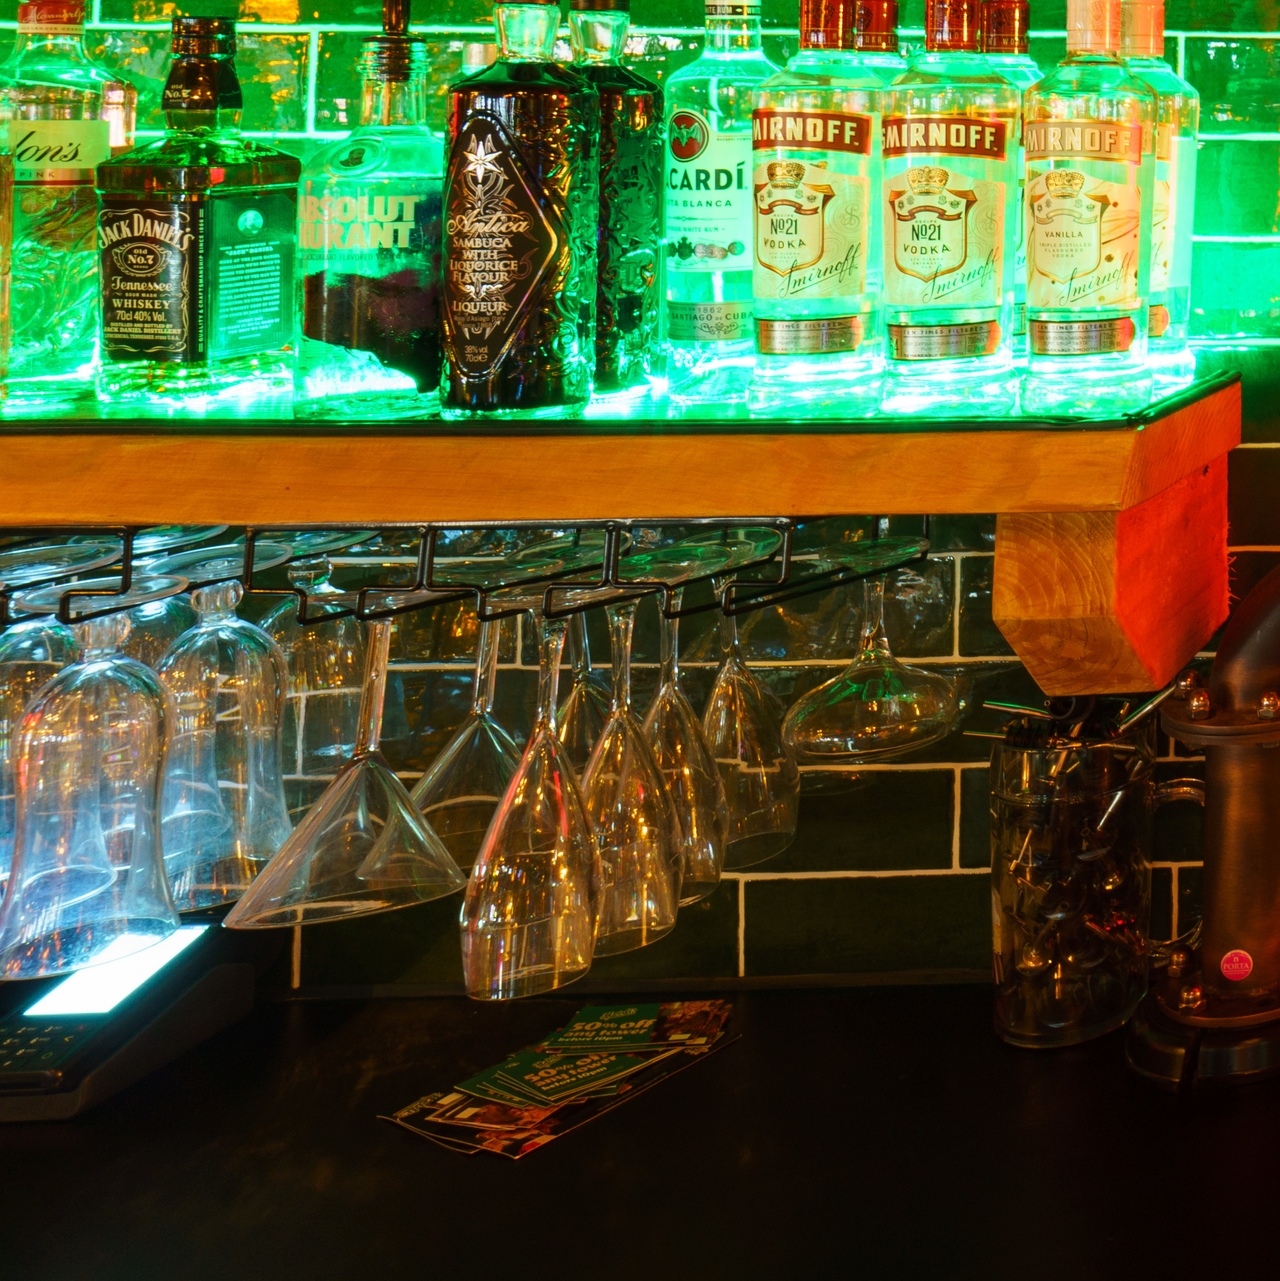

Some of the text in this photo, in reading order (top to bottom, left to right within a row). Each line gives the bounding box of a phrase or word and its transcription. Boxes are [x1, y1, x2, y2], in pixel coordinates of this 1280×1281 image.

[164, 89, 191, 100] No.7
[19, 171, 56, 179] PINK
[446, 208, 531, 236] Antica
[98, 212, 196, 252] JACK DANIEL'S
[1044, 230, 1084, 239] VANILLA
[452, 236, 513, 249] SAMBUCA
[763, 236, 807, 250] VODKA
[462, 249, 498, 260] WITH
[903, 242, 953, 257] VODKA
[127, 254, 155, 265] No.7
[450, 260, 519, 273] LIQUORICE
[779, 242, 862, 299] Smirnoff
[453, 271, 511, 283] FLAVOUR
[1058, 249, 1135, 307] Smirnoff
[111, 275, 173, 293] Tennessee
[112, 298, 172, 311] WHISKEY
[453, 300, 510, 316] LIQUEUR
[697, 306, 723, 315] 1862
[116, 310, 167, 322] 70cl 40% Vol.
[671, 312, 714, 323] SANTIAGO
[725, 311, 755, 322] CUBA
[1036, 324, 1048, 332] TEN
[1077, 322, 1114, 331] FILTERED
[572, 1017, 658, 1038] 50% off
[557, 1035, 624, 1047] before 10pm
[562, 1028, 649, 1045] any tower
[523, 1062, 575, 1084] 50%
[534, 1055, 618, 1089] any tower
[540, 1065, 608, 1092] before 10pm
